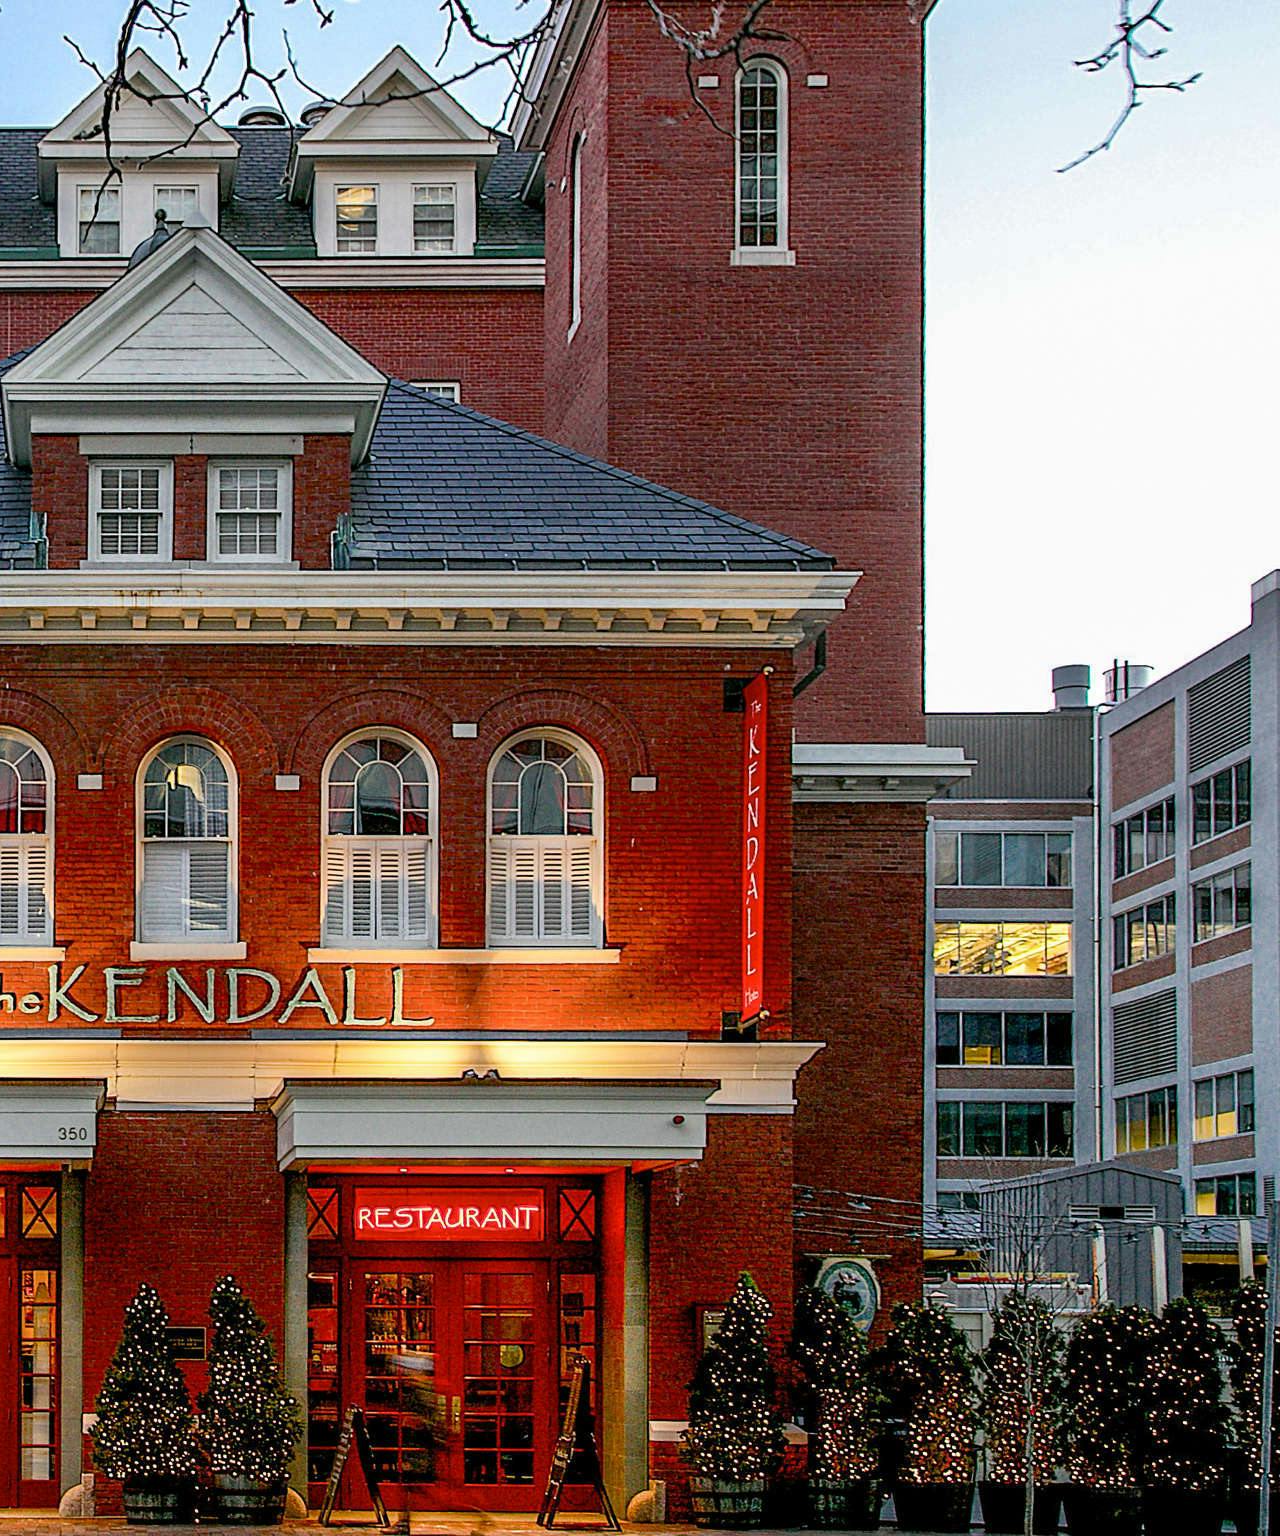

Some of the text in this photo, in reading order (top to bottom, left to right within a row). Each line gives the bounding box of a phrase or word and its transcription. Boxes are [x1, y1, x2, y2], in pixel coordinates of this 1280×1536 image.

[746, 724, 760, 976] KENDALL
[47, 963, 435, 1027] KENDALL
[58, 1127, 88, 1141] 350
[358, 1206, 540, 1230] RESTAURANT
